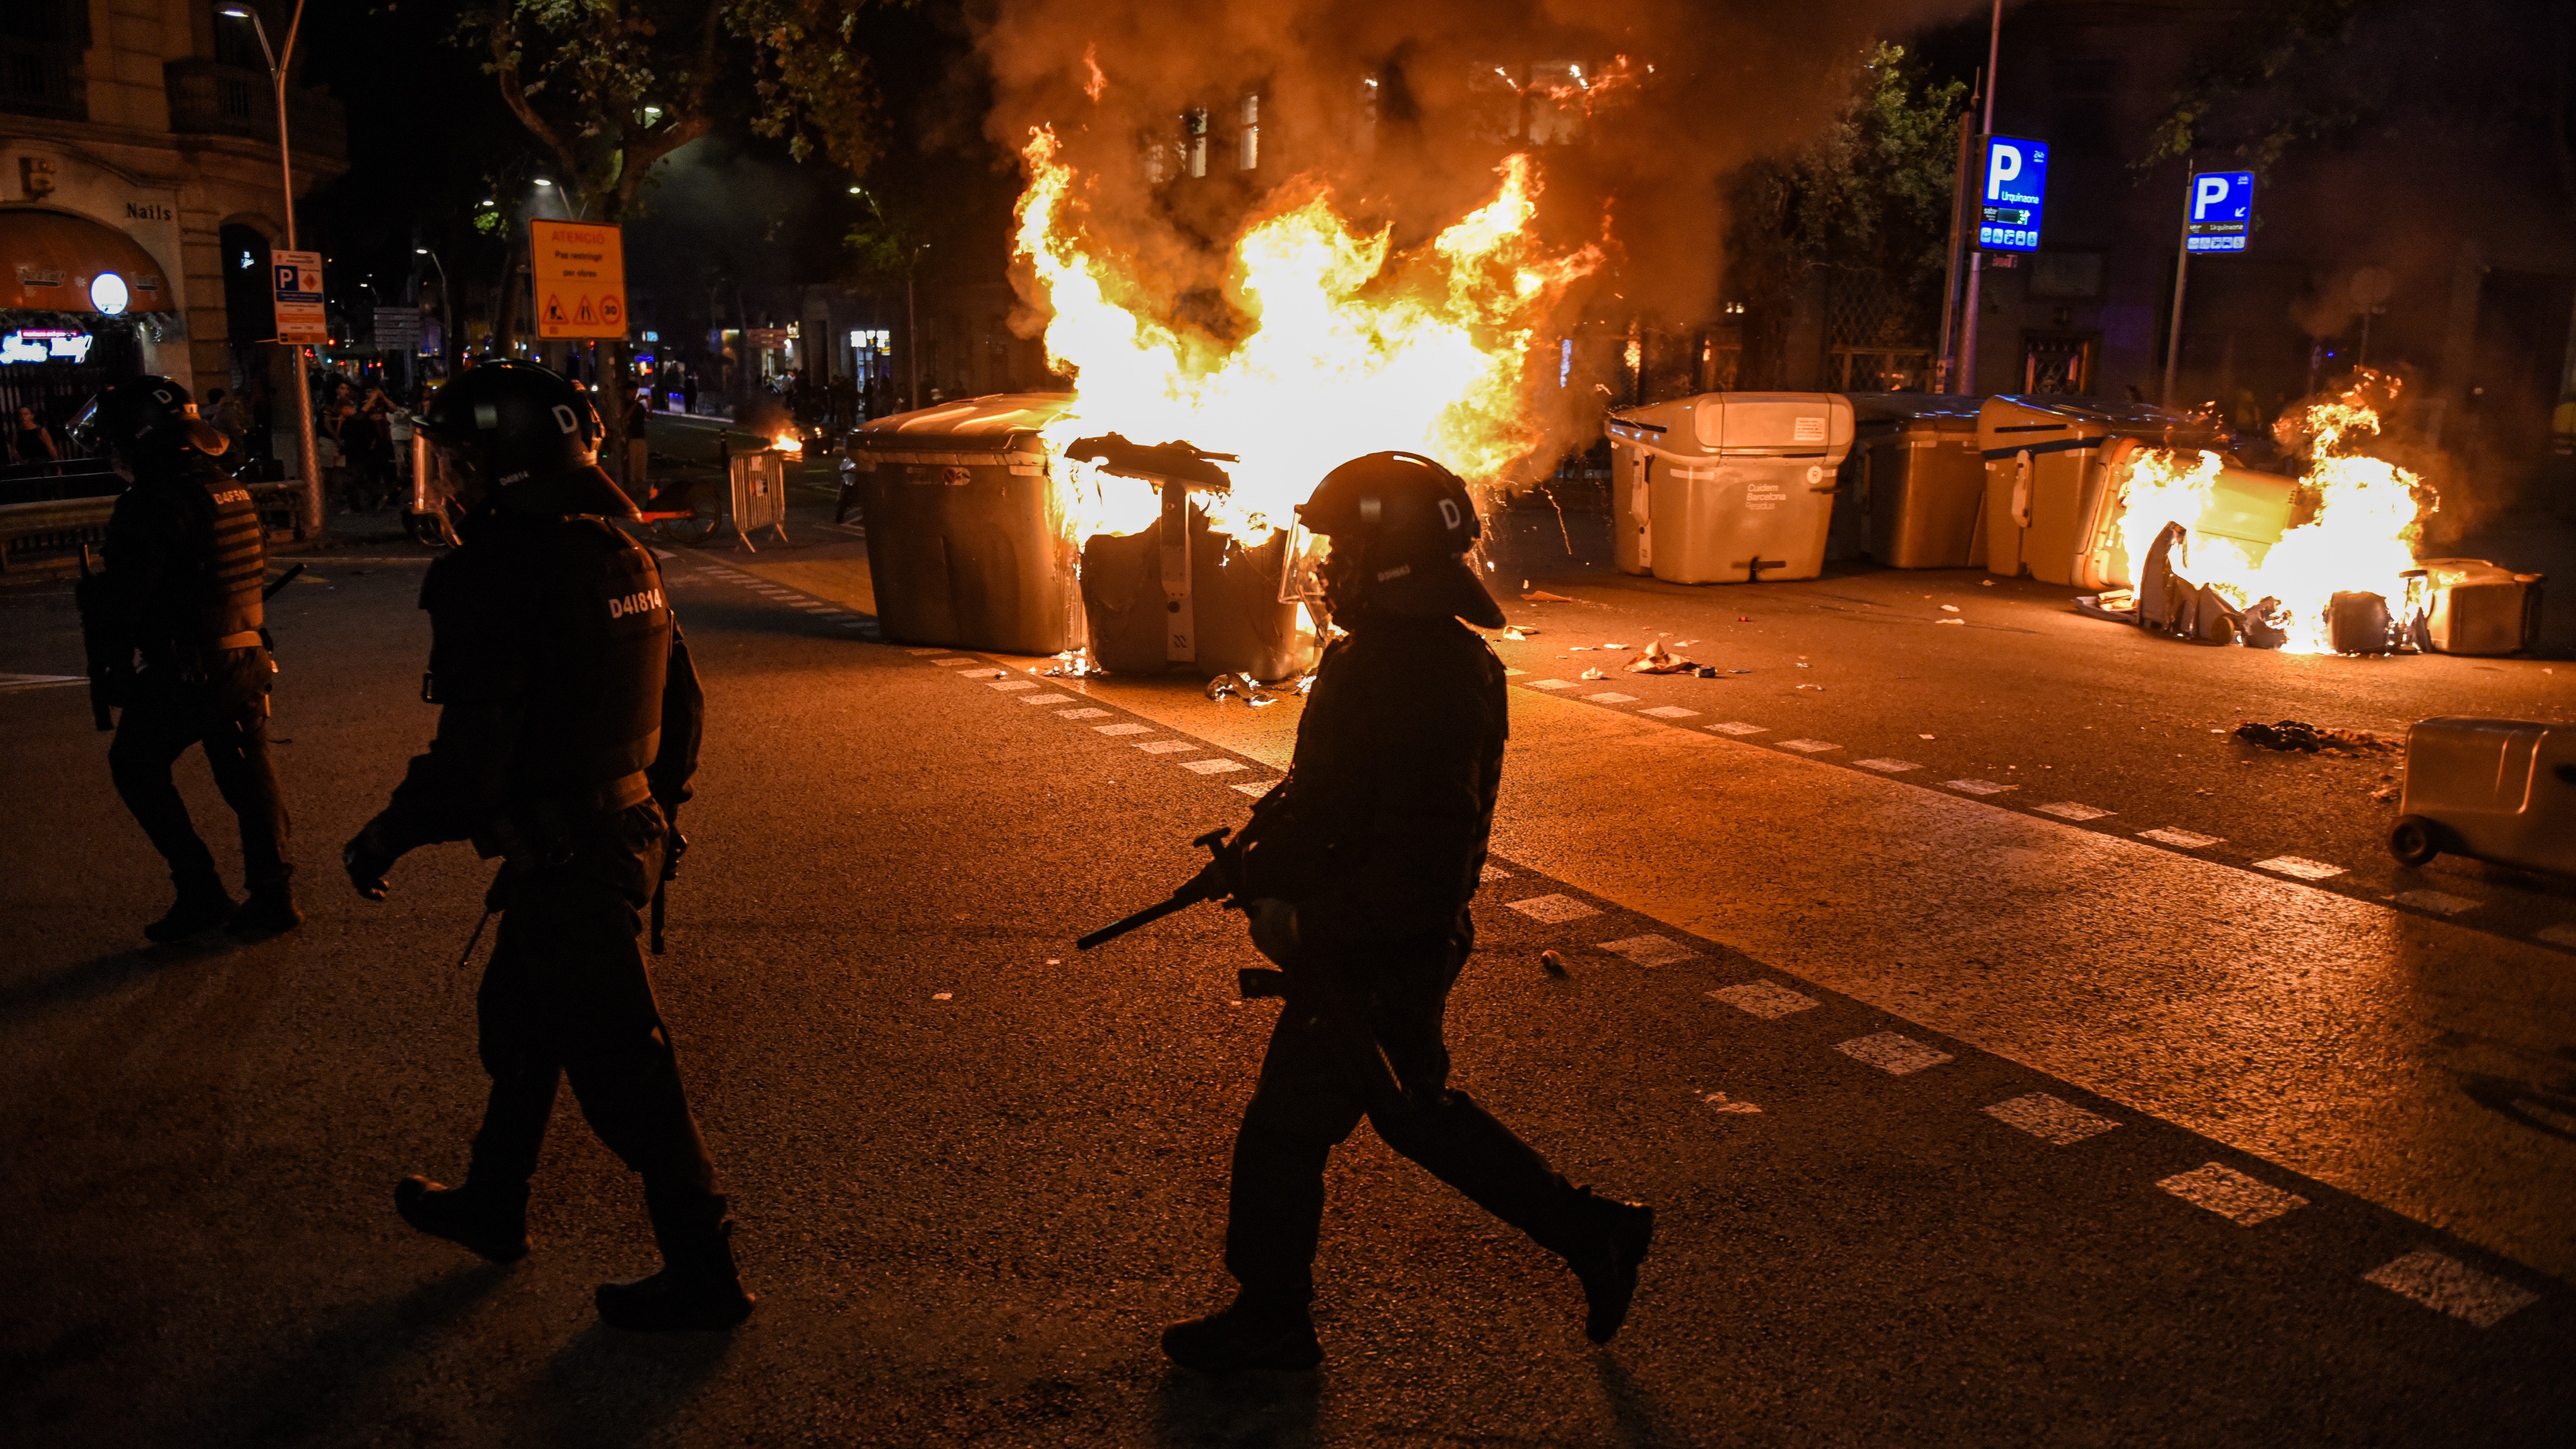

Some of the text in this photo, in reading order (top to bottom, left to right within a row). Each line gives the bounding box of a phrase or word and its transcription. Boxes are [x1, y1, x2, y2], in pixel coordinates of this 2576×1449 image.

[1988, 144, 2021, 200] P
[2001, 191, 2039, 204] Urquinaona
[2194, 177, 2229, 220] P
[126, 202, 171, 221] Nails
[280, 268, 293, 289] P
[605, 305, 617, 315] 30
[152, 388, 173, 405] D
[552, 404, 578, 434] D
[1747, 483, 1779, 492] Cuidem
[1747, 492, 1786, 501] Barcelona
[1437, 498, 1461, 530] D
